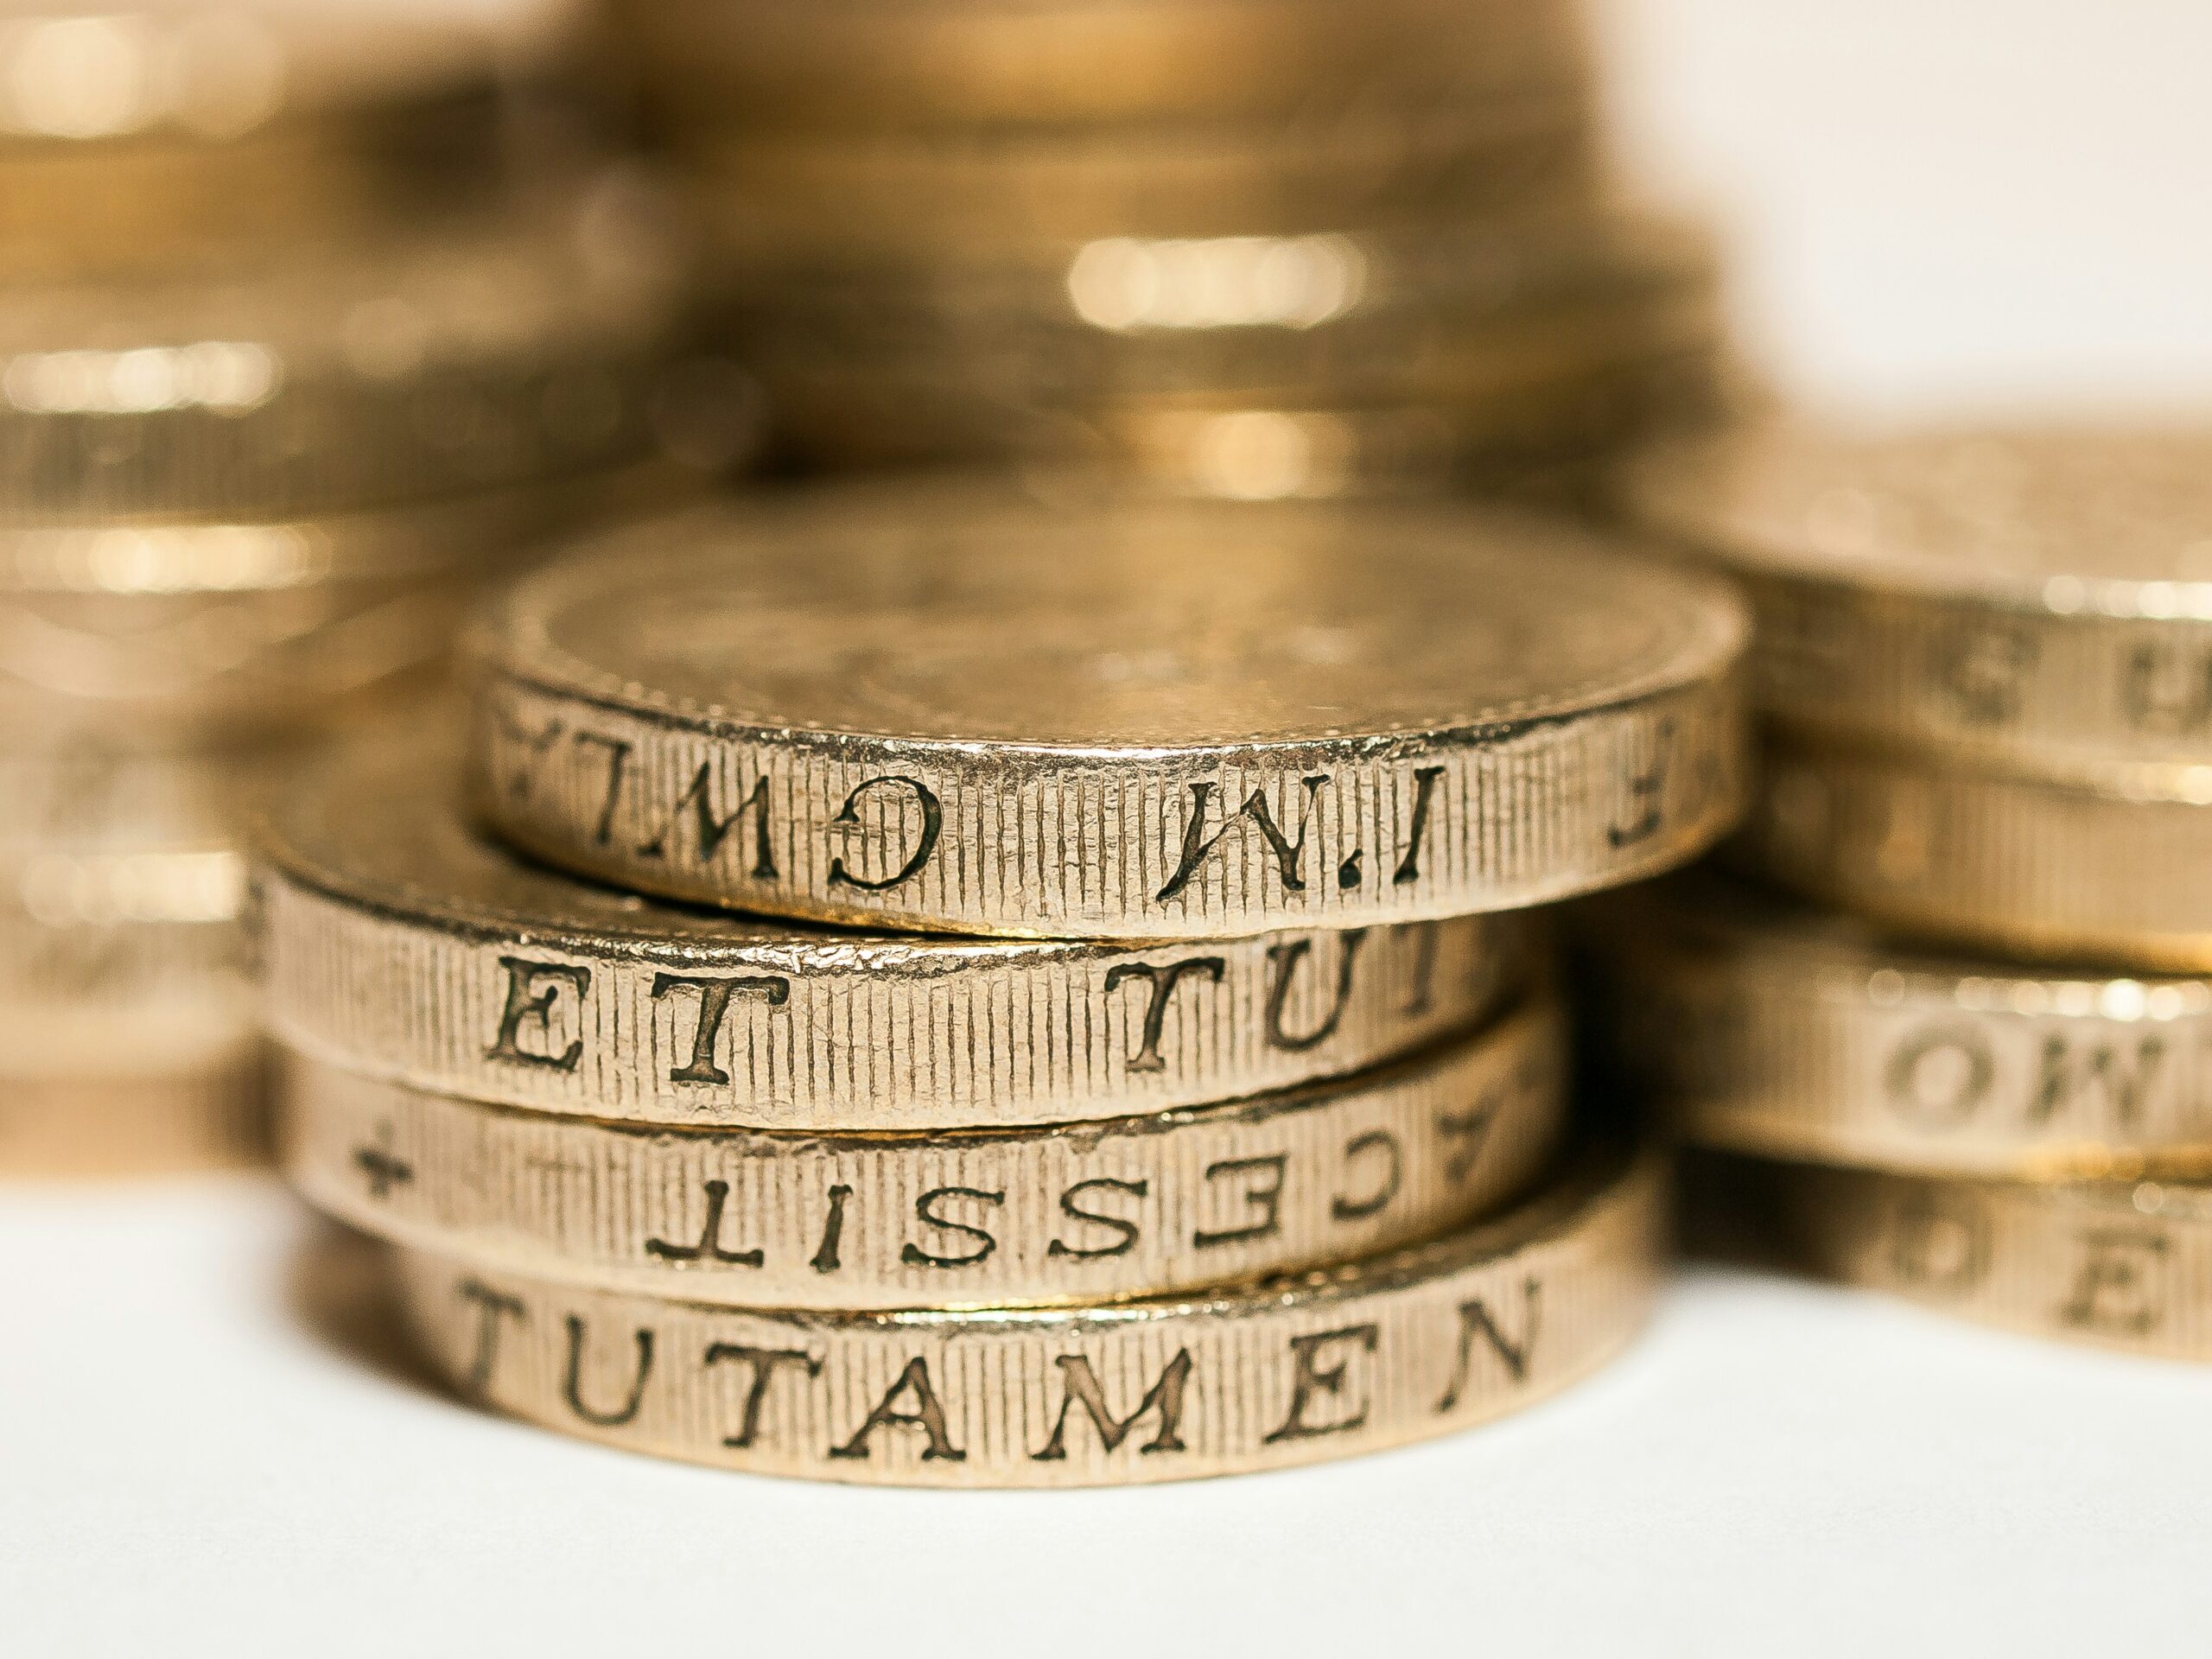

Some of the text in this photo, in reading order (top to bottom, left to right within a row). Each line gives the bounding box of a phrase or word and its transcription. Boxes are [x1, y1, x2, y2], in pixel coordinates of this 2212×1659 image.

[1154, 765, 1446, 904] I'M
[486, 954, 790, 1086] ET
[456, 1280, 1543, 1460] TUTAMEN
